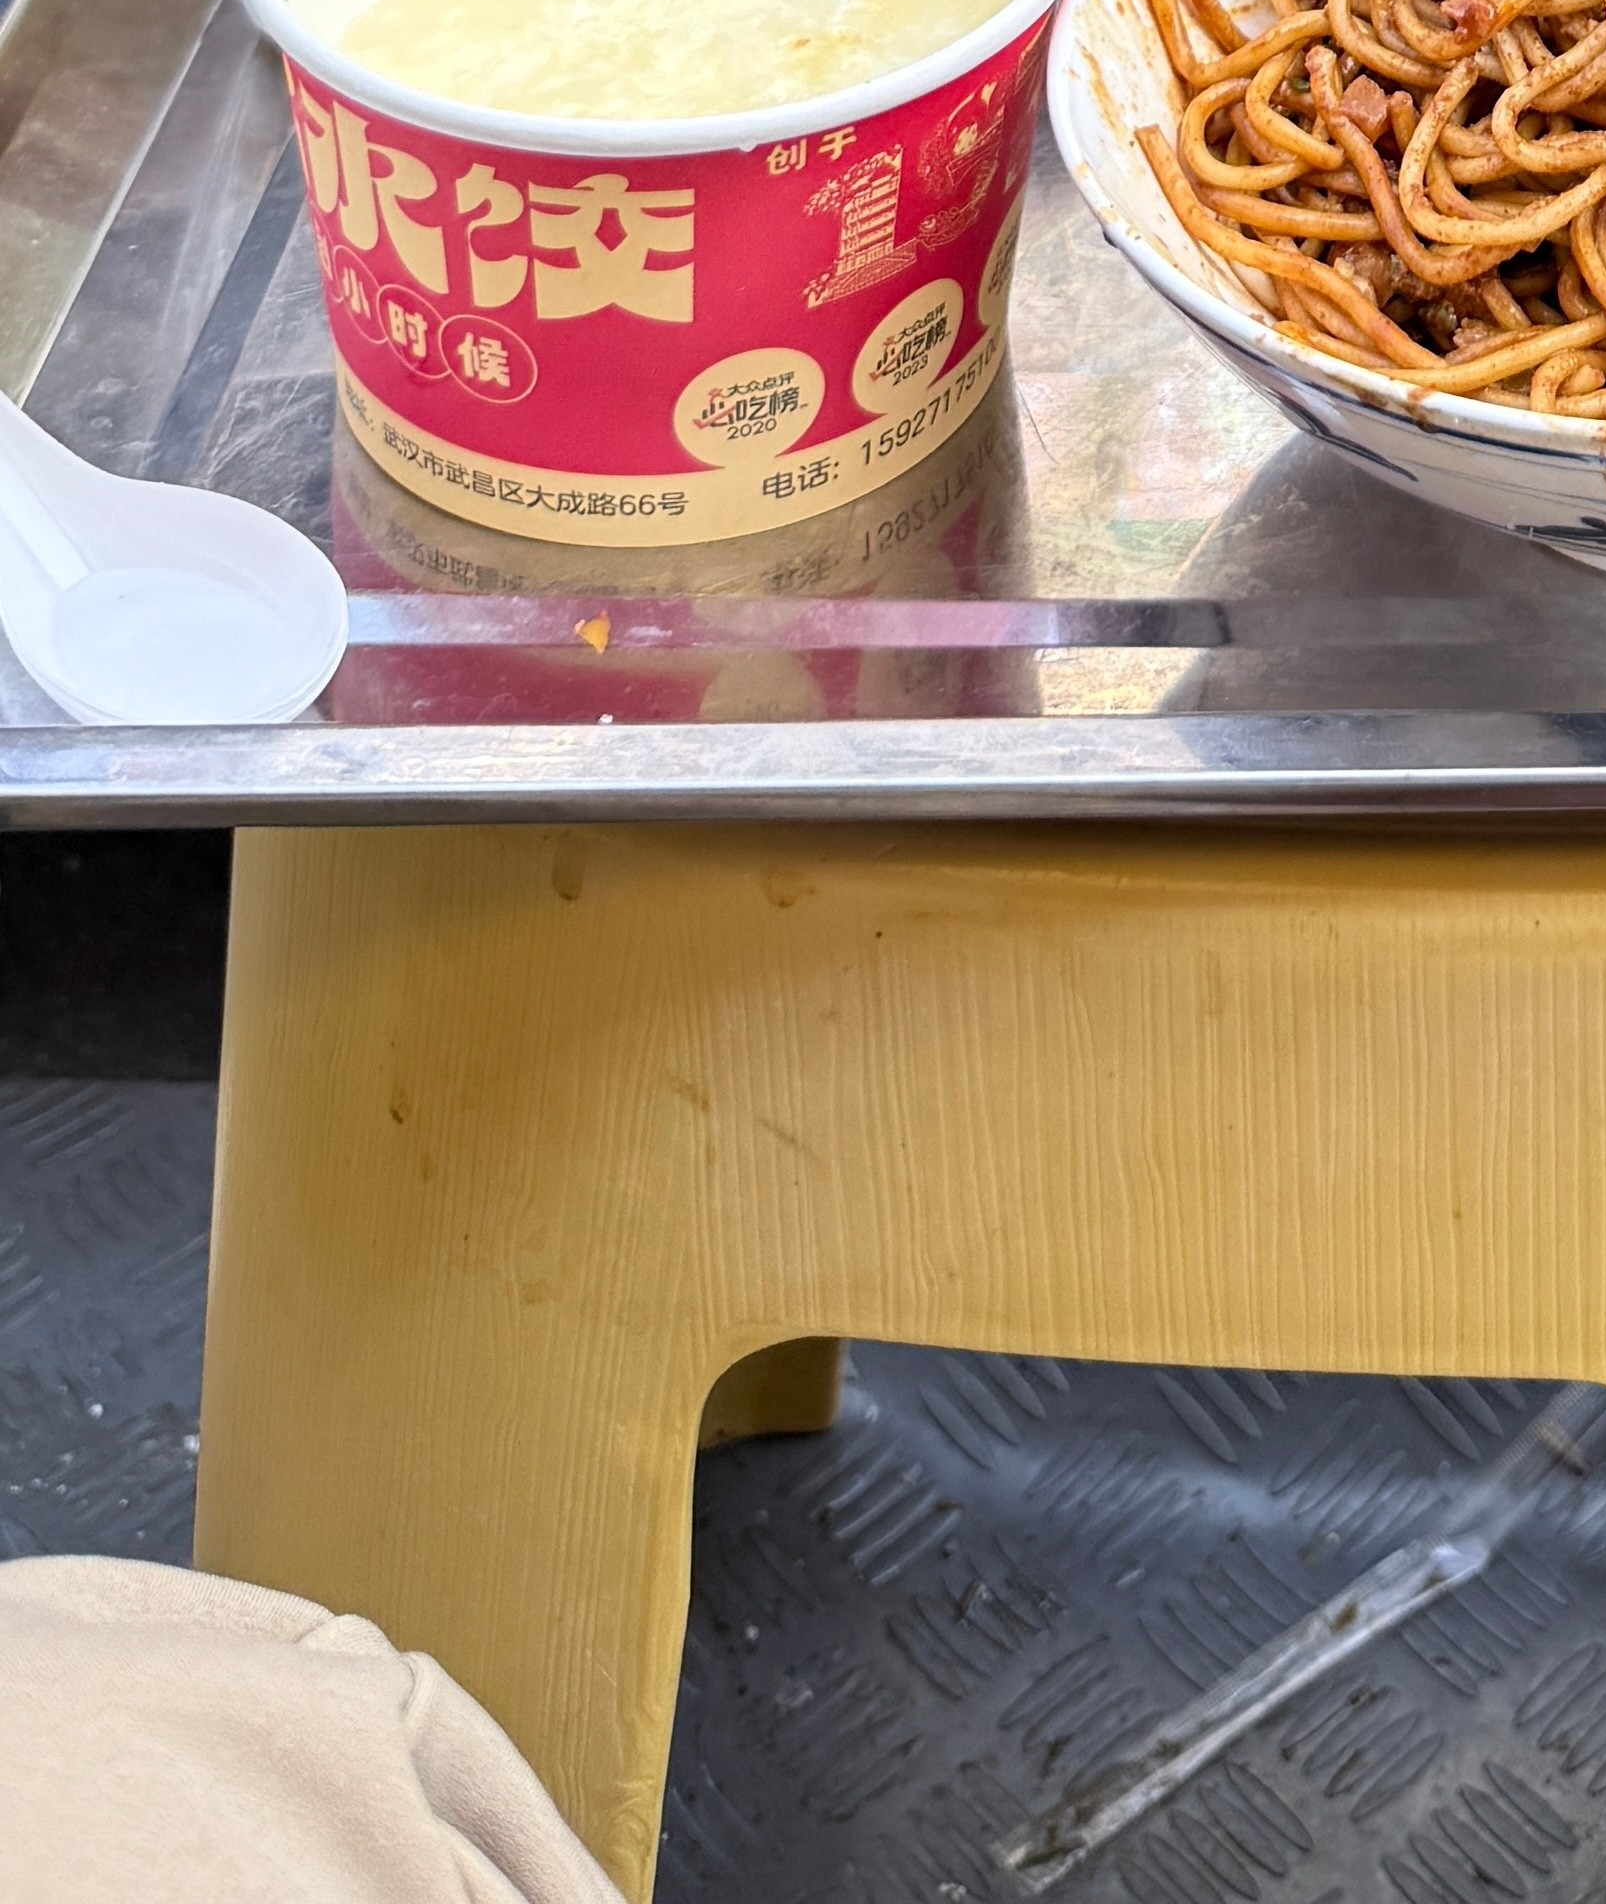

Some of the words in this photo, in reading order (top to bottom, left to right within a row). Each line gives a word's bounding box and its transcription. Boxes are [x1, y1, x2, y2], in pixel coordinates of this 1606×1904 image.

[766, 127, 857, 175] 创于
[298, 80, 695, 323] 水饺
[728, 372, 795, 397] 大众点评
[892, 357, 928, 387] 2023
[693, 387, 800, 429] 必吃榜
[727, 418, 777, 440] 2020
[382, 422, 690, 517] 武汉市武昌区大成路66号
